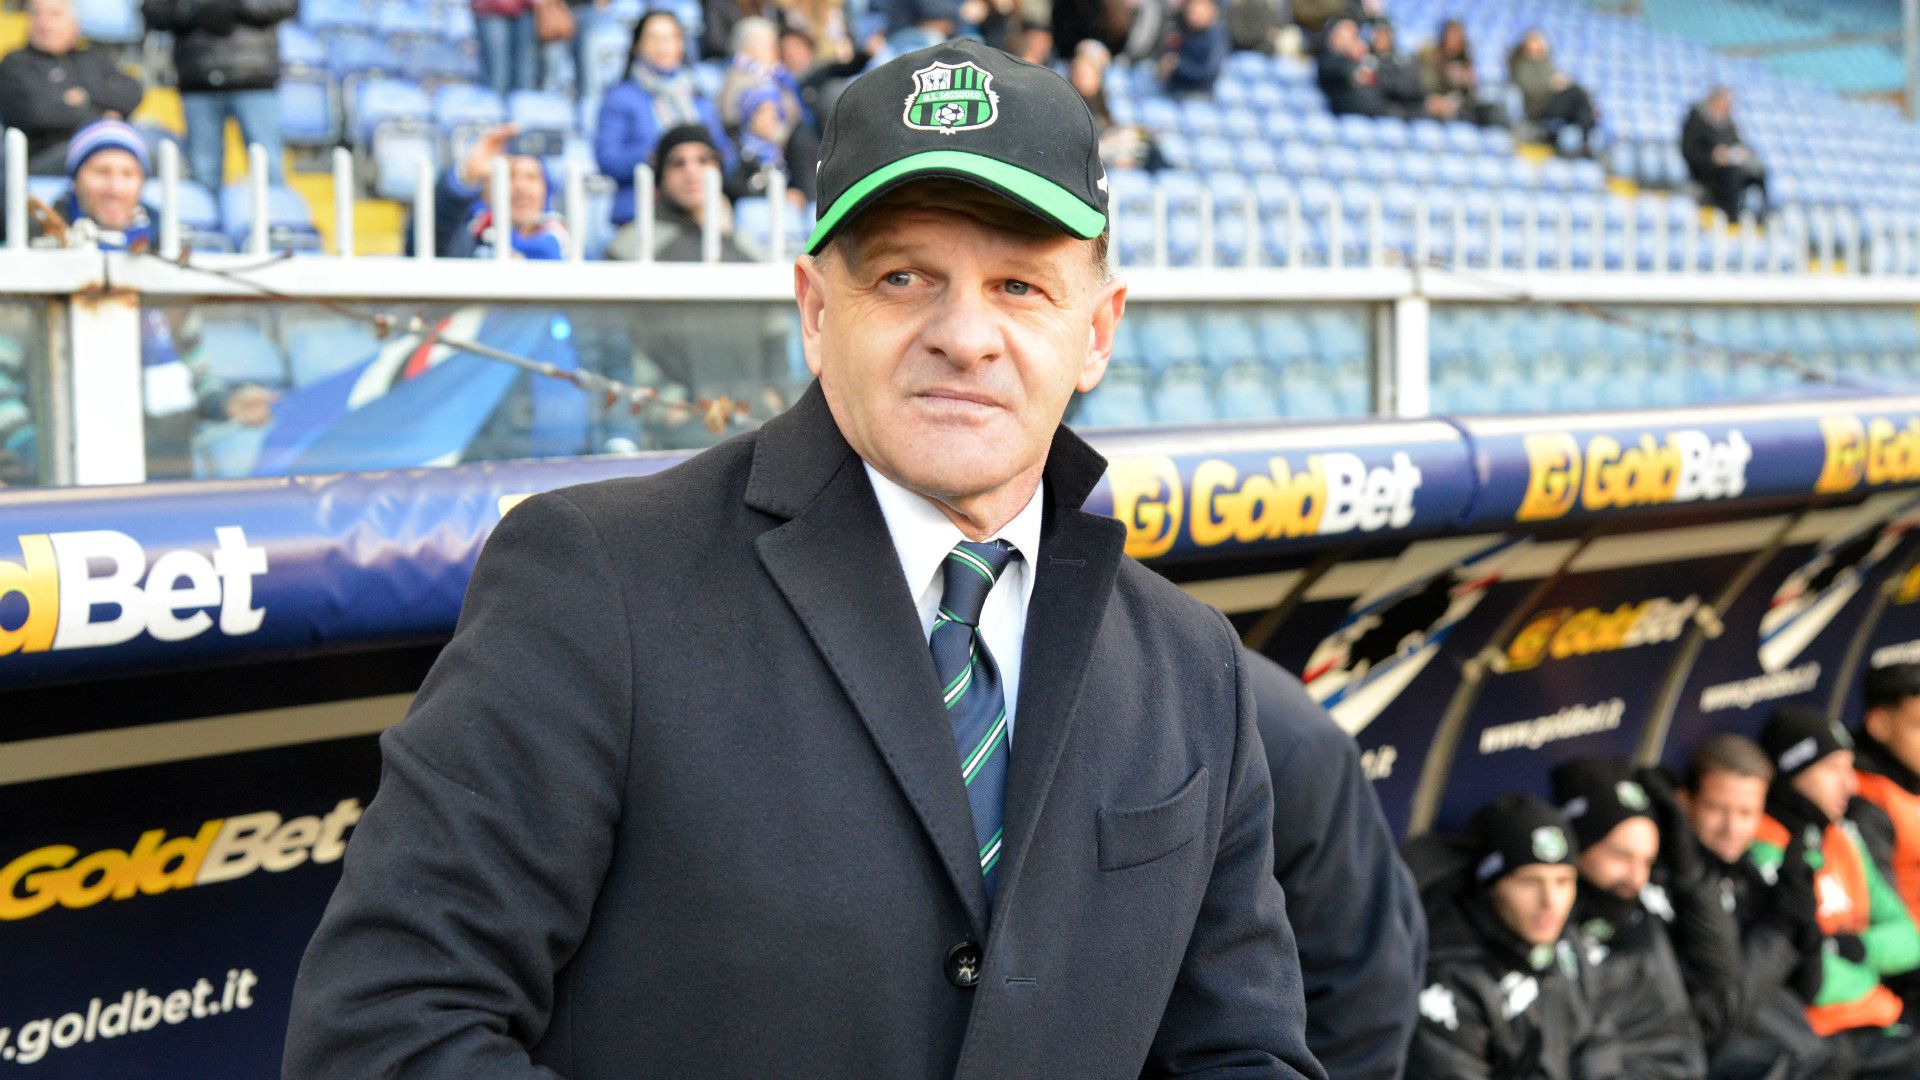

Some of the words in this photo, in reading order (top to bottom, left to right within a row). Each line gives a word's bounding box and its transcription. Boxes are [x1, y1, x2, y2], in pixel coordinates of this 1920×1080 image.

[1189, 450, 1422, 547] GoldBet
[1582, 429, 1753, 512] GoldBet
[0, 798, 364, 921] GoldBet
